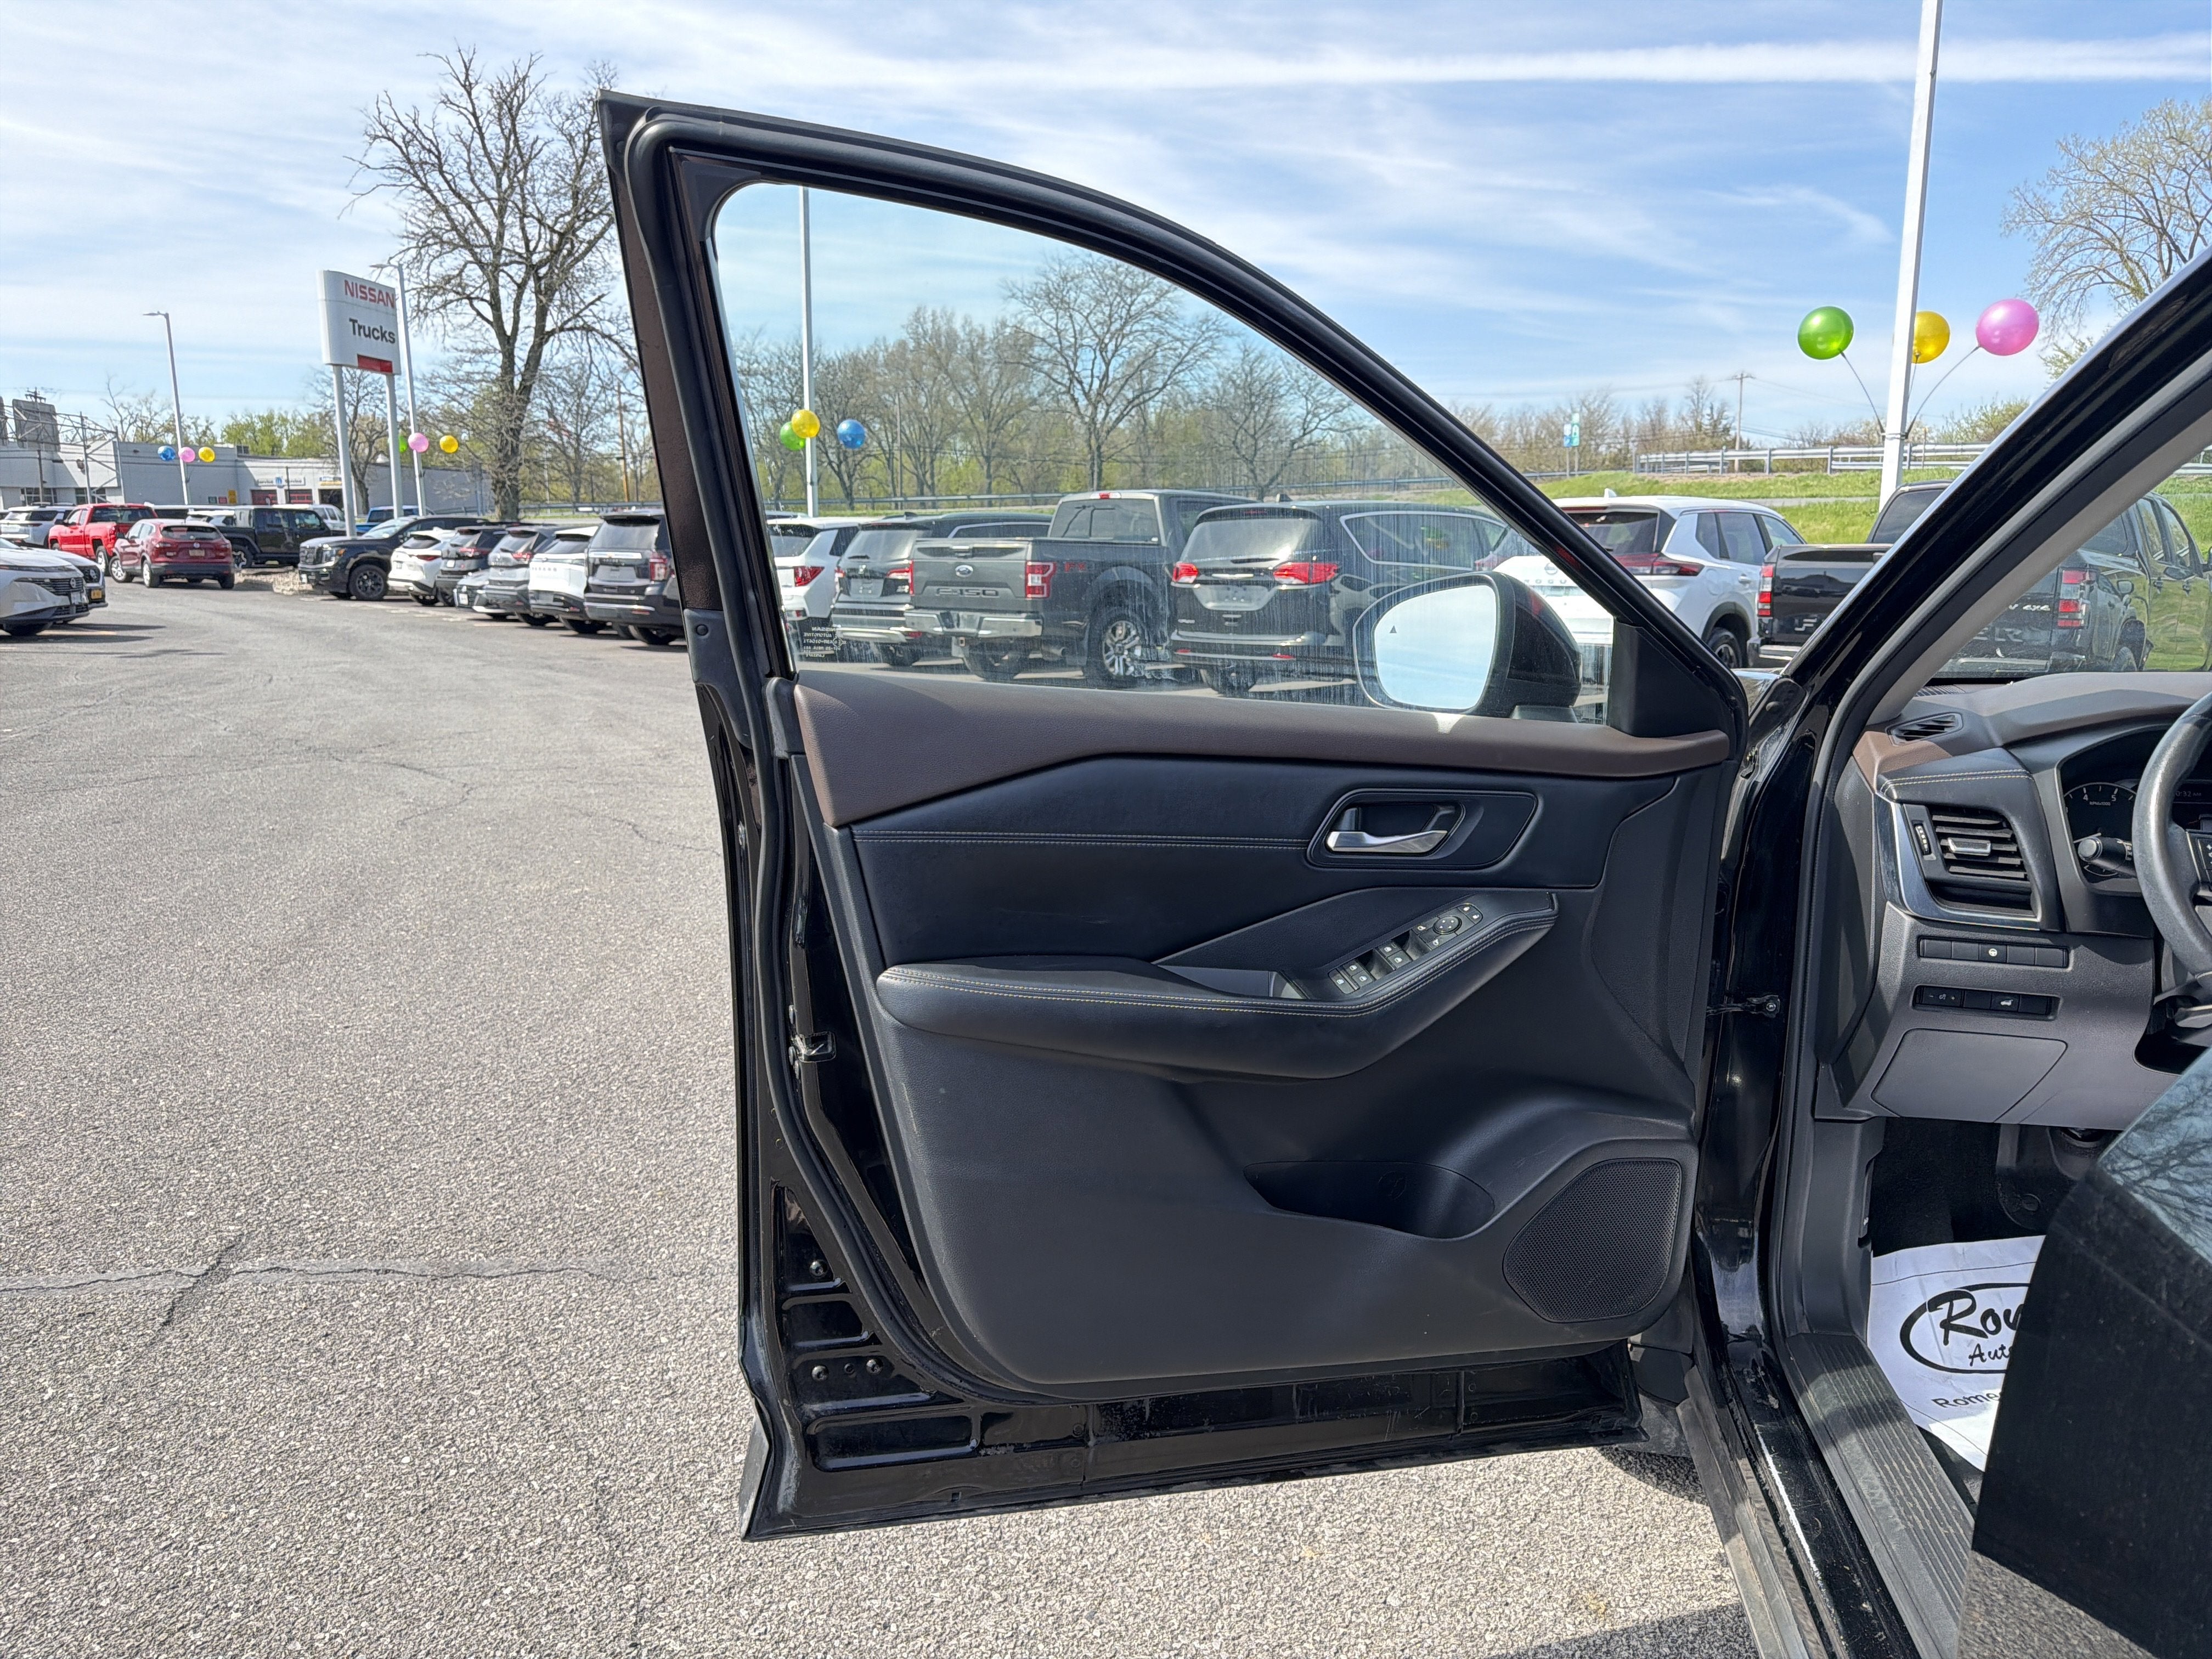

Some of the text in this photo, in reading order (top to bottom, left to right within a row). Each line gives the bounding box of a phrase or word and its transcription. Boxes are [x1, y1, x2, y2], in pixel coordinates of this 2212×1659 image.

[344, 280, 395, 308] NISSAN
[349, 317, 396, 344] Trucks
[1931, 1392, 2002, 1408] Rome
